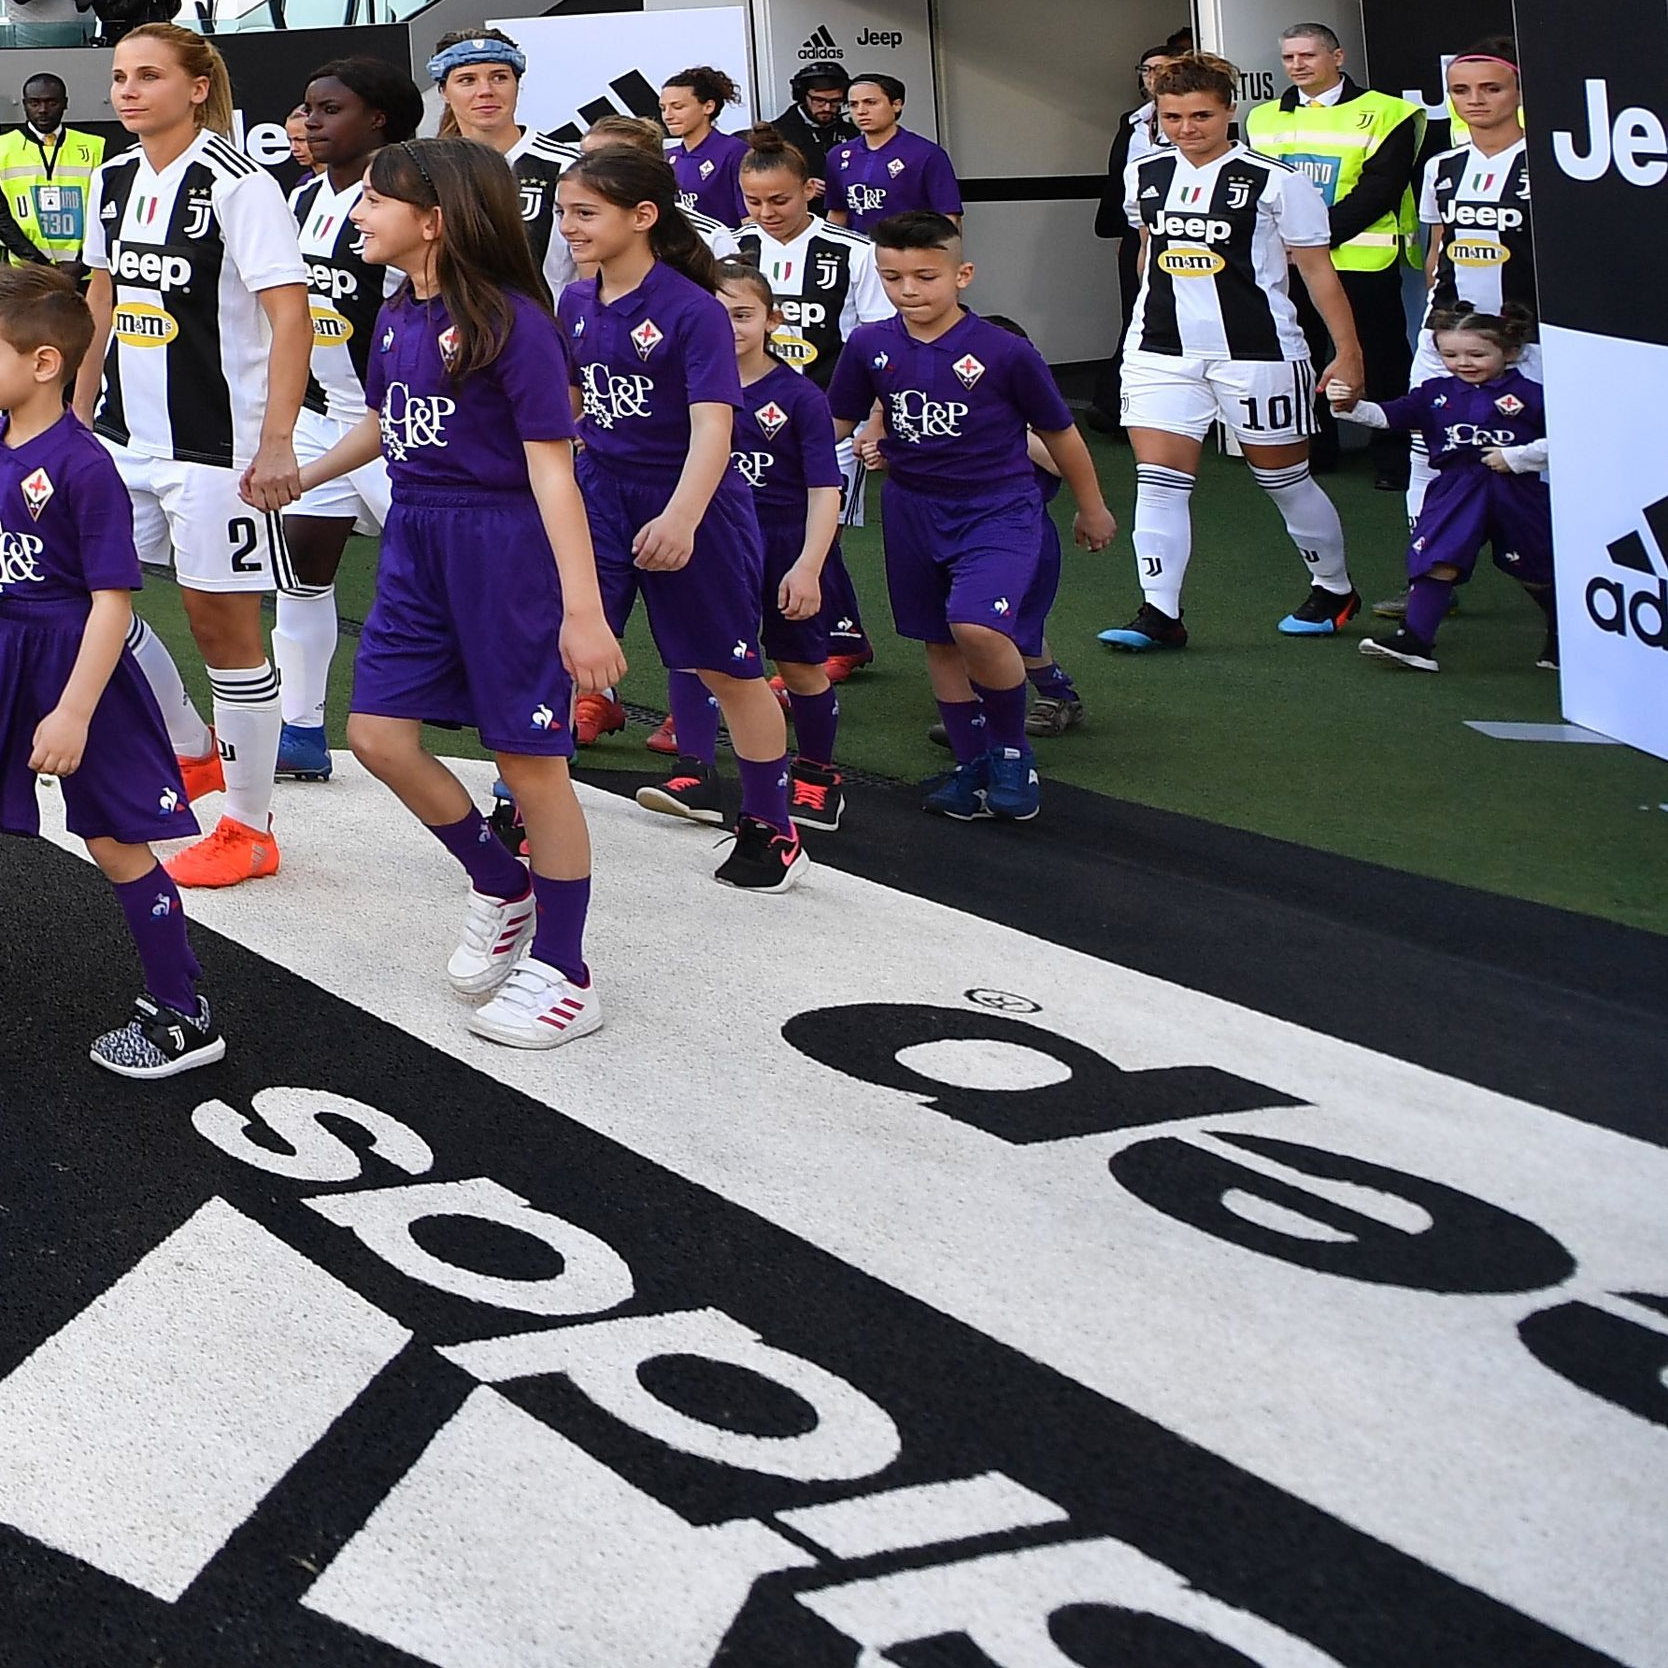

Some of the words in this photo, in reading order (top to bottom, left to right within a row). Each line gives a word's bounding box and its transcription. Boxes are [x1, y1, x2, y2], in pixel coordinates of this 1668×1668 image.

[797, 45, 844, 60] adidas
[856, 28, 903, 49] Jeep
[1149, 210, 1230, 244] Jeep
[1441, 200, 1520, 230] Jeep
[107, 240, 192, 292] Jeep
[1240, 394, 1292, 431] 10
[227, 517, 263, 573] 2
